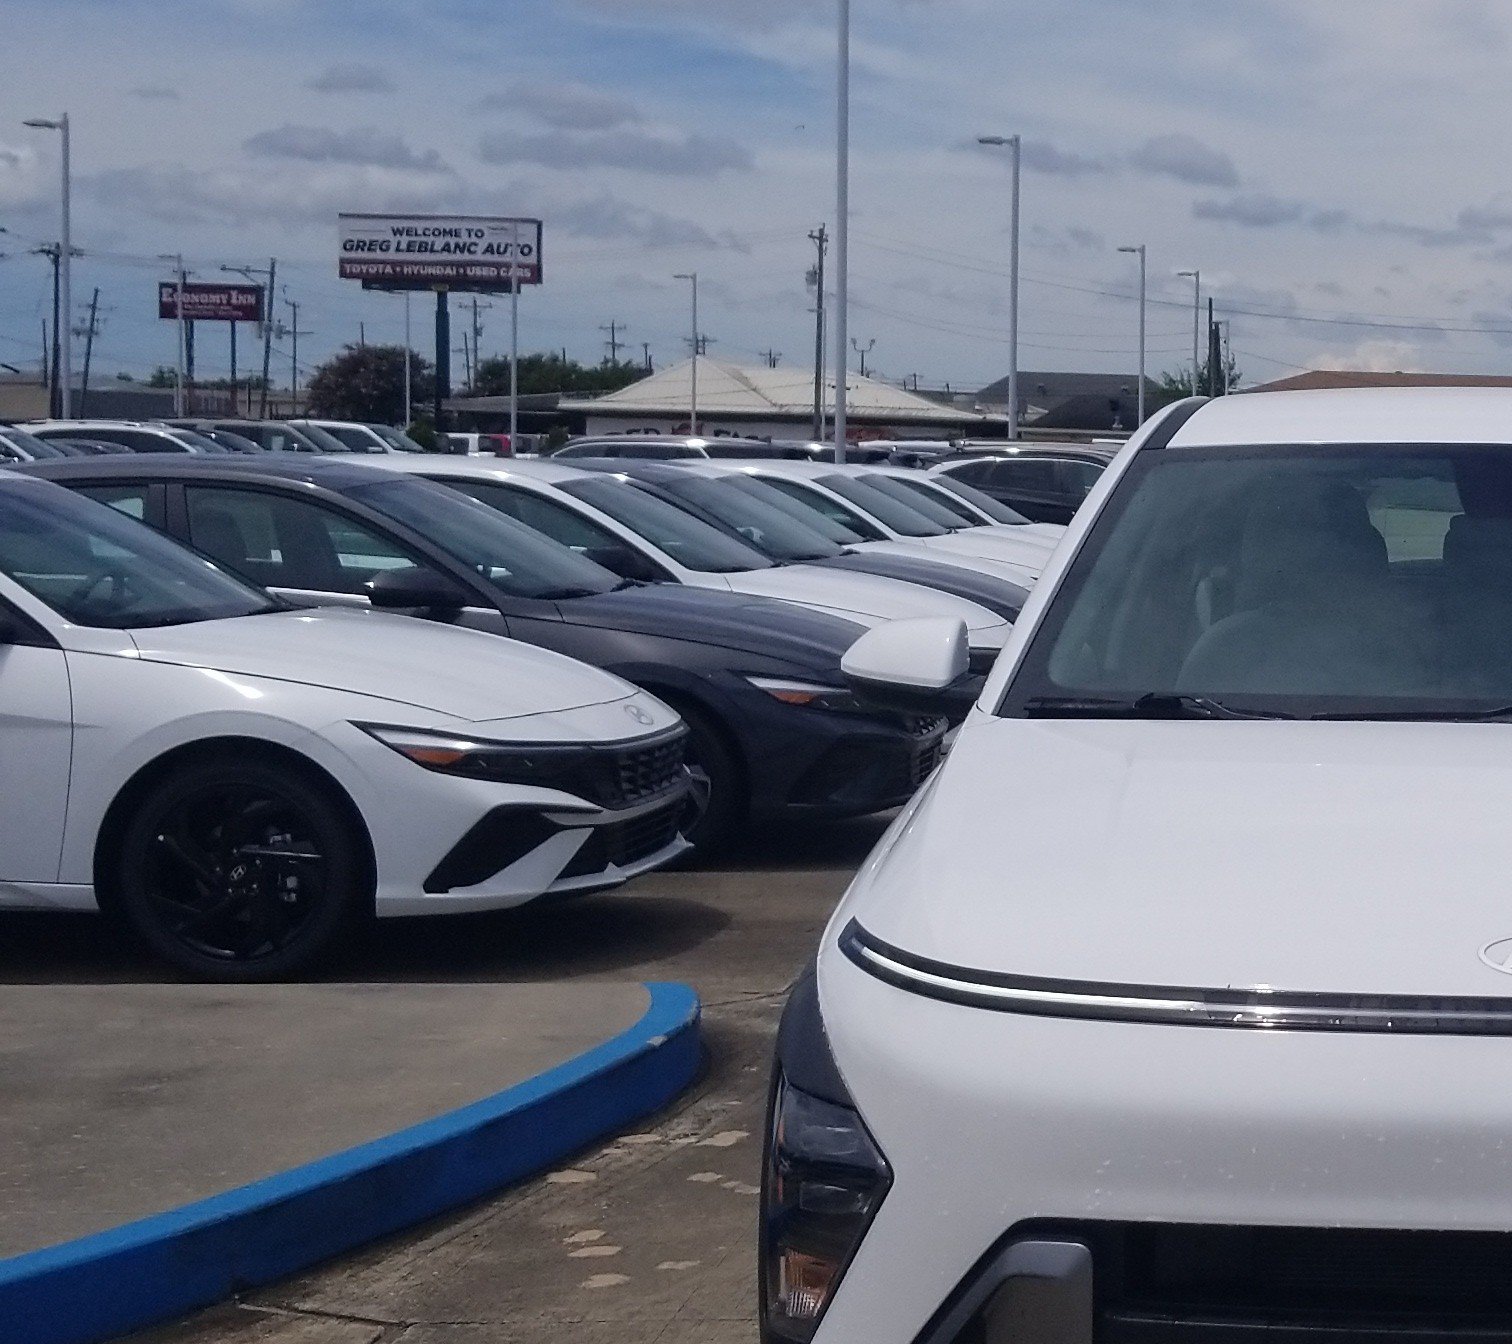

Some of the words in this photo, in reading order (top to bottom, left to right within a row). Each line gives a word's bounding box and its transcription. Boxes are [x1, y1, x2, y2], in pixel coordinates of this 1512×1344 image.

[391, 225, 462, 239] WELCOME
[466, 228, 486, 239] TO
[342, 238, 391, 253] GREG
[395, 240, 479, 256] LEBLANC
[344, 263, 395, 275] TOYOTA
[403, 265, 457, 276] HYUNDAI
[466, 266, 498, 277] USED
